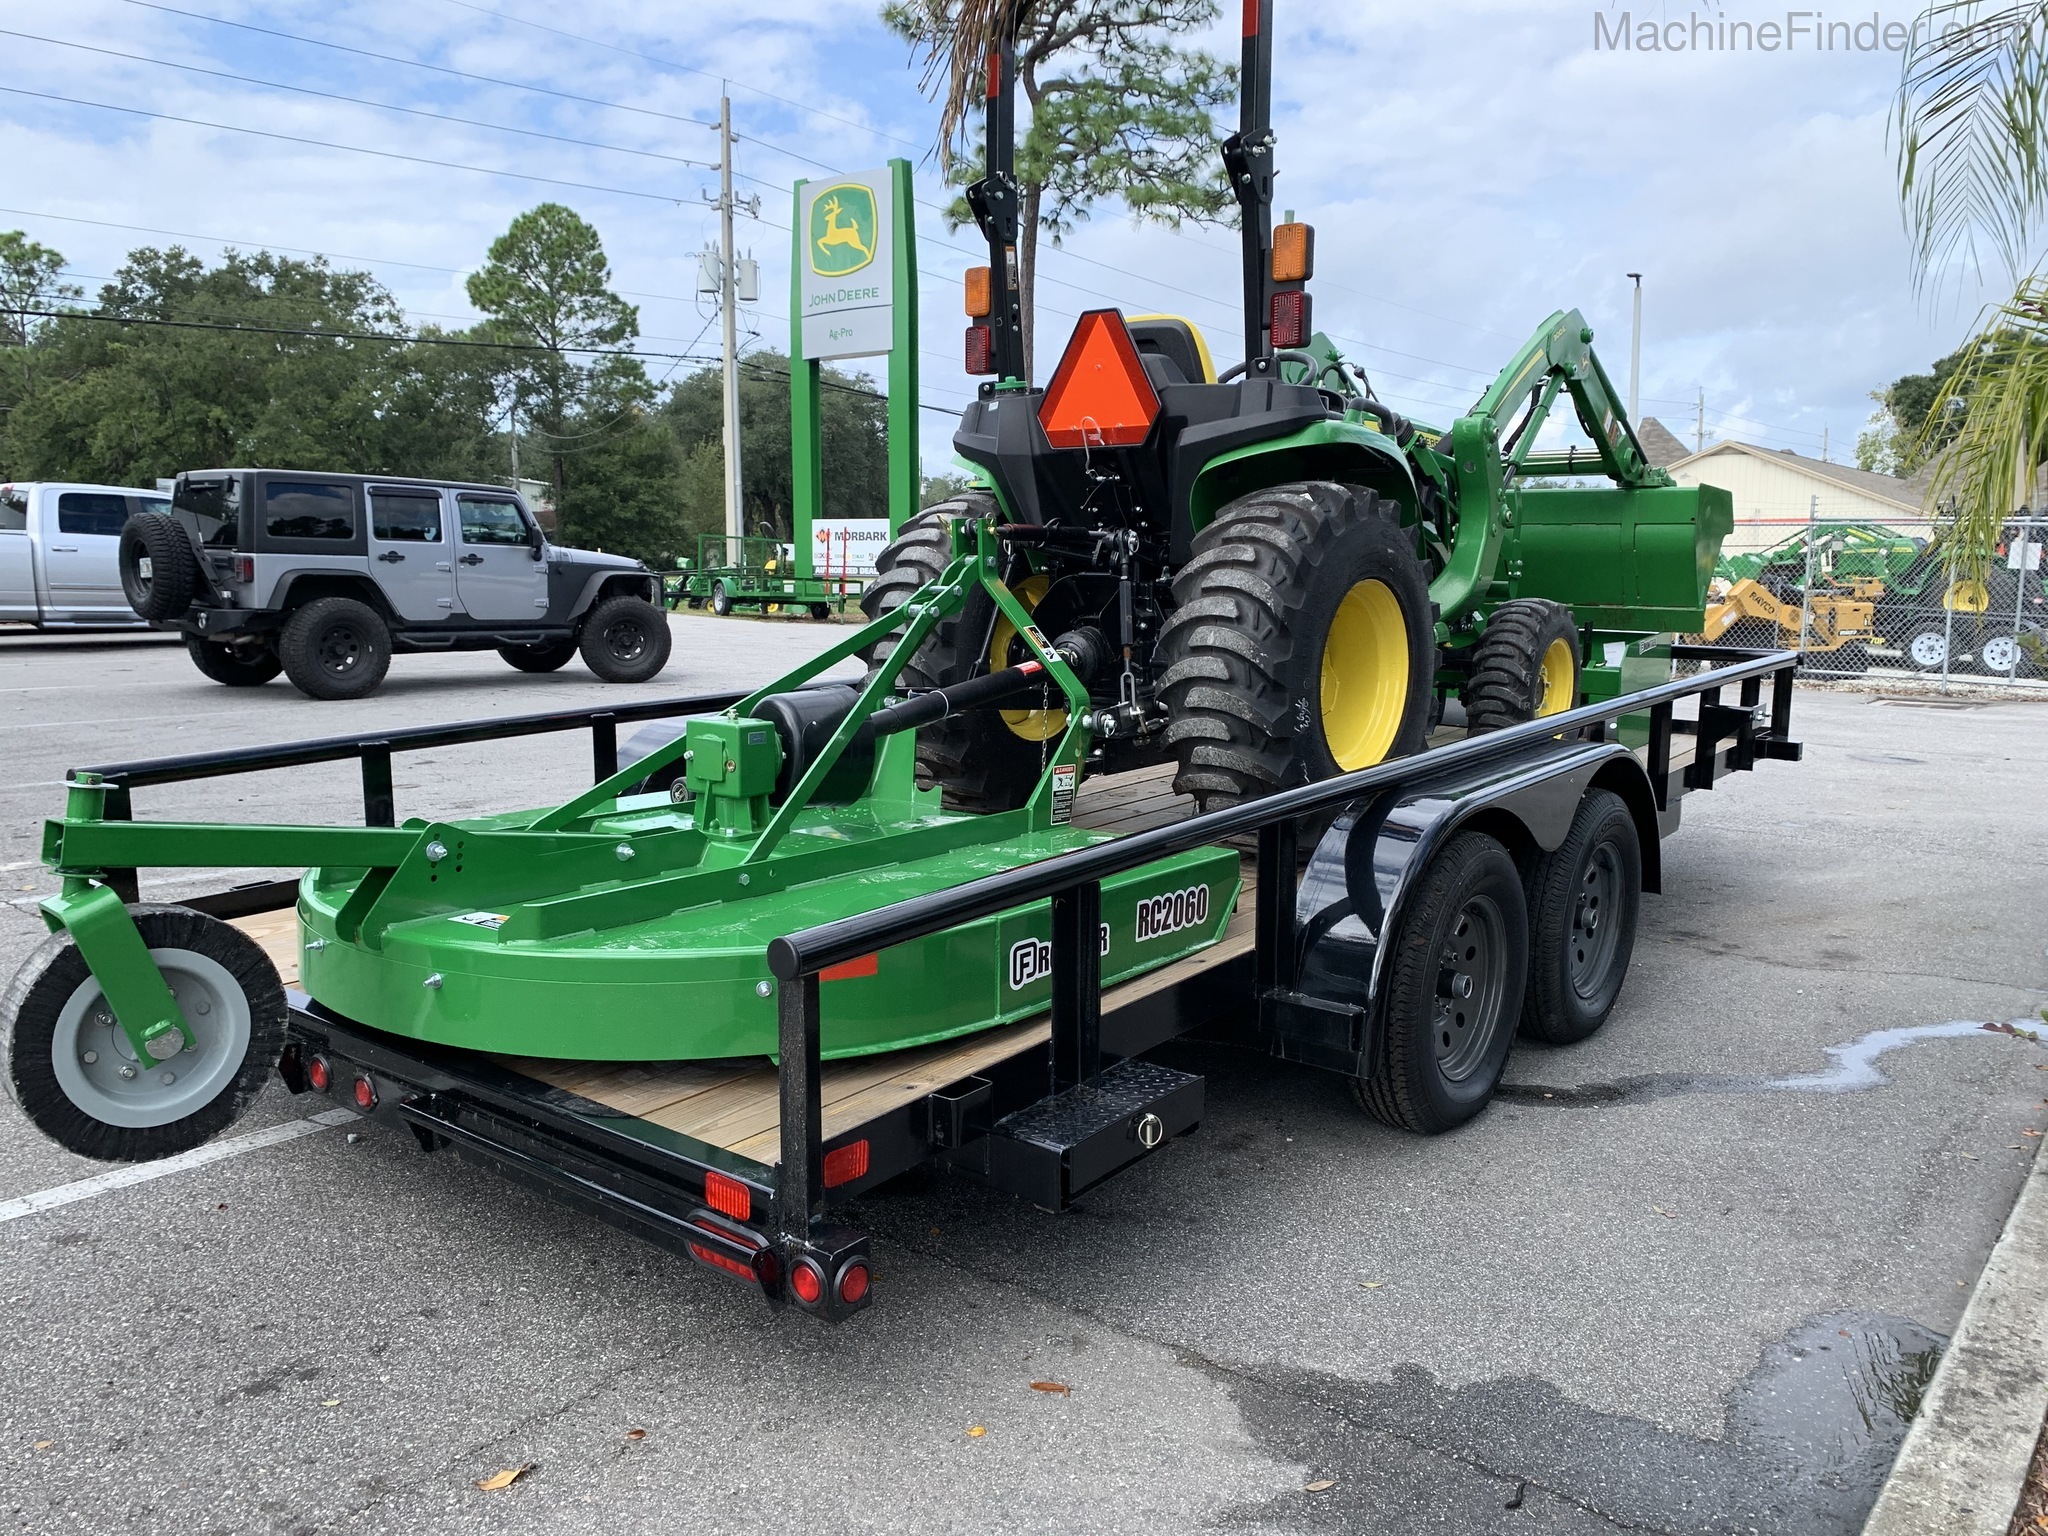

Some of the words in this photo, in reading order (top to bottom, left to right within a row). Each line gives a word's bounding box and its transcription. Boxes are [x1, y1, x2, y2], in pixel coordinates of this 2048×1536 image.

[809, 292, 836, 307] JOHN
[837, 287, 879, 302] DEERE
[829, 327, 853, 341] Ag-Pro
[834, 531, 887, 541] MORBARK
[815, 566, 858, 574] AUTHORZED
[859, 567, 879, 575] DEAL
[1748, 591, 1775, 615] RAYCO
[1137, 885, 1208, 940] RC2060
